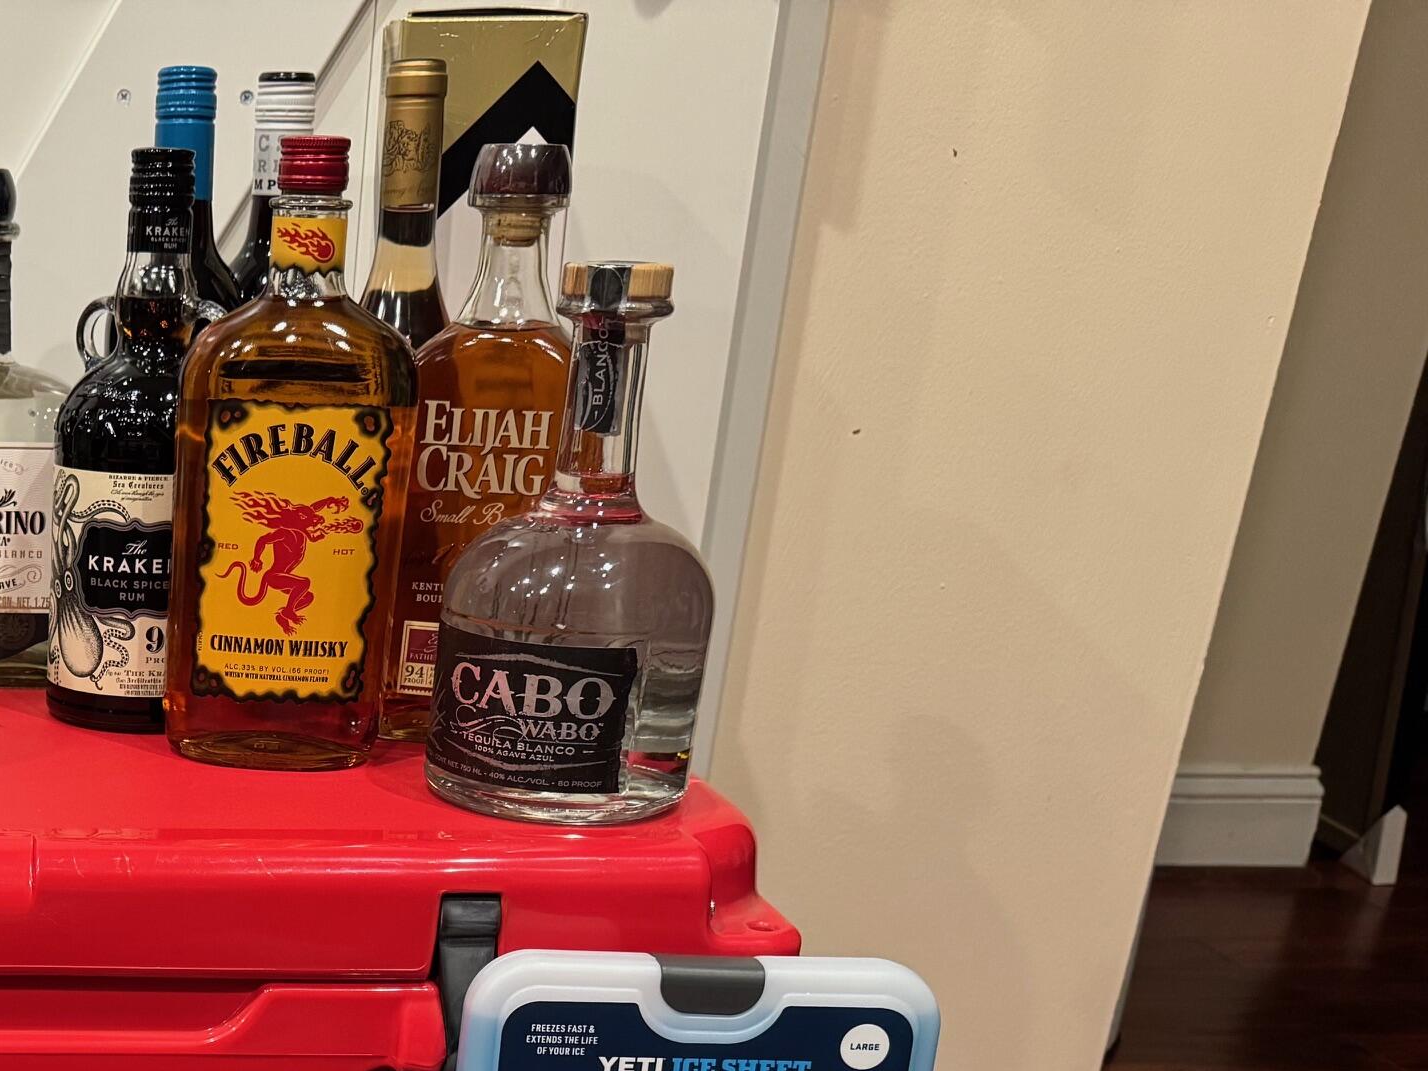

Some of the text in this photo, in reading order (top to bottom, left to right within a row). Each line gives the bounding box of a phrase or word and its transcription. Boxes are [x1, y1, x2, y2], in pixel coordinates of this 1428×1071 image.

[420, 399, 554, 455] ELIJAH
[211, 422, 377, 488] FIREBALL
[417, 445, 547, 499] CRAIG
[420, 499, 475, 524] Small
[122, 539, 148, 556] The
[217, 542, 239, 551] RED
[332, 548, 356, 556] HOT
[90, 577, 170, 590] BLACK SPICE
[119, 591, 145, 602] RUM
[210, 634, 348, 658] CINNAMON WHISKY
[404, 664, 425, 678] 94
[451, 661, 618, 720] CABO
[518, 719, 601, 742] WABO
[496, 749, 555, 762] AGAVE AZUL
[516, 742, 575, 756] BLANCO
[572, 780, 602, 788] PROOF
[531, 1023, 587, 1033] FREEZES FAST
[526, 1035, 599, 1045] EXTENDS THE LIFE
[536, 1046, 585, 1056] OF YOUR ICE
[849, 1043, 880, 1051] LARGE
